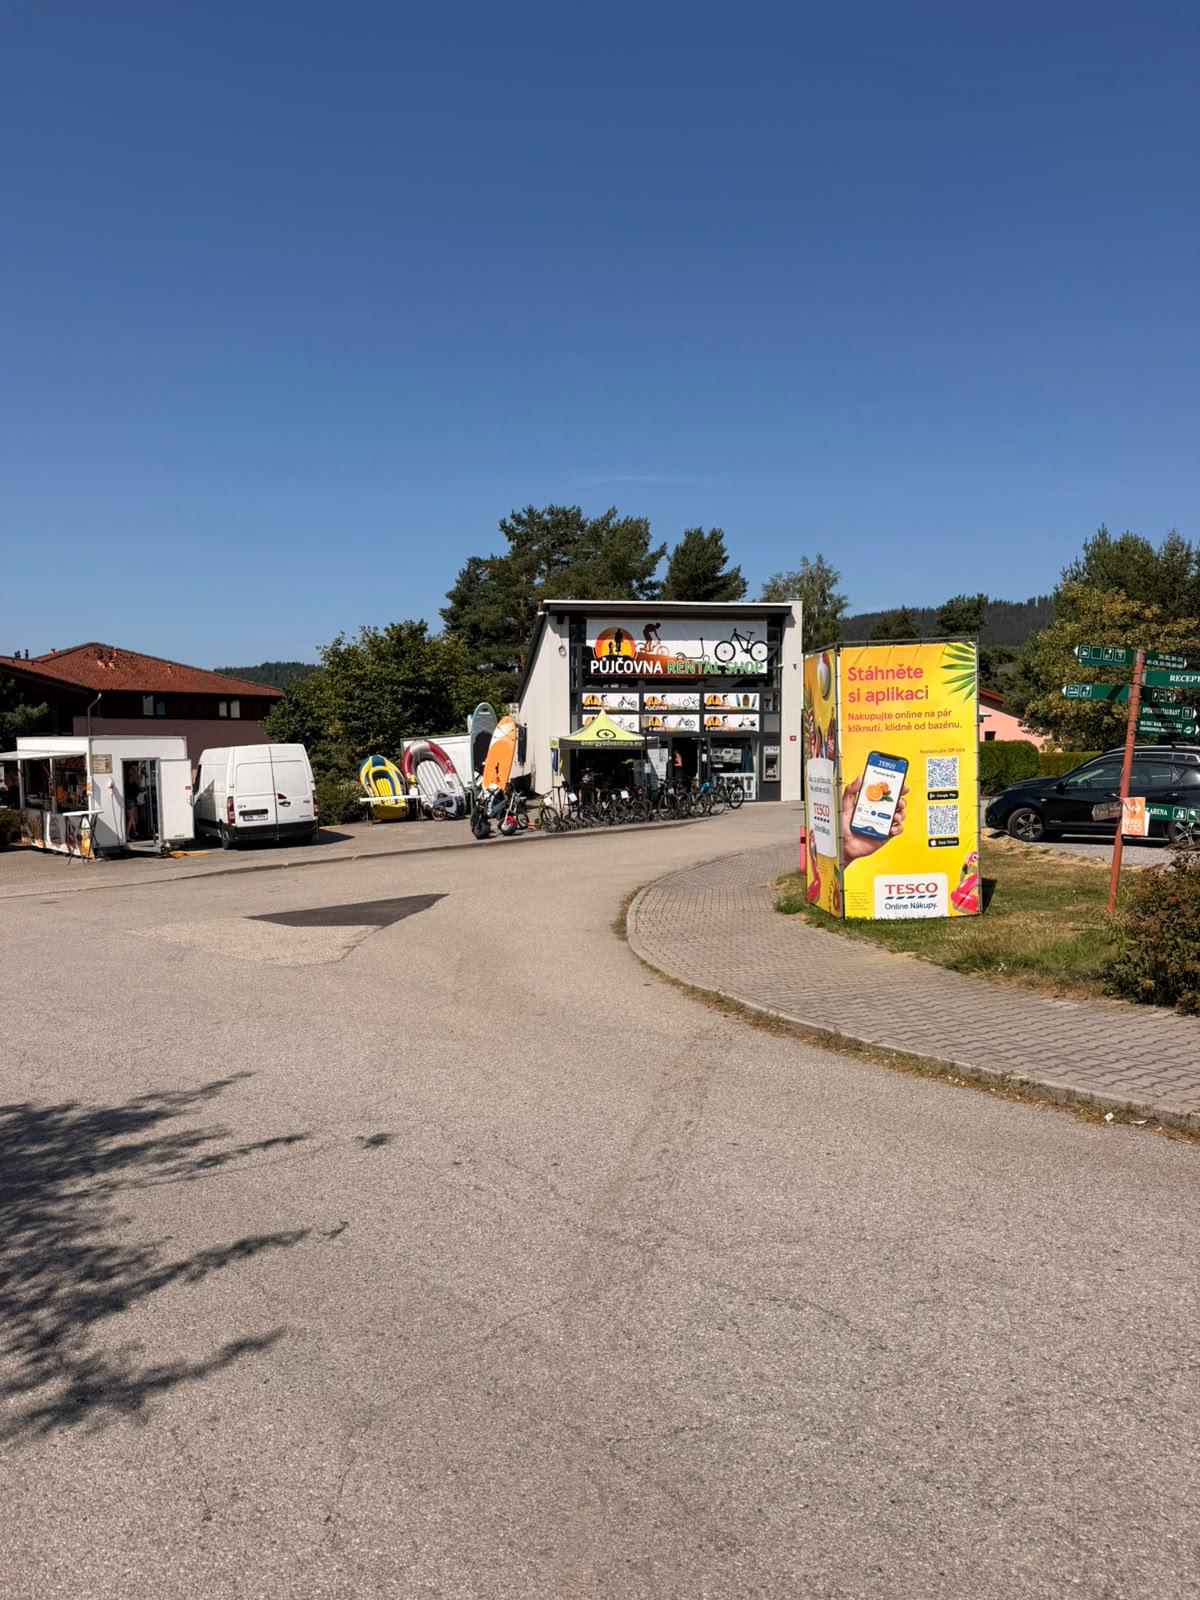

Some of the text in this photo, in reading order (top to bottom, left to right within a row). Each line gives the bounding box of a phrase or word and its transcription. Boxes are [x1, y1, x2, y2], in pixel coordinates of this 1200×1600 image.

[590, 656, 763, 675] PŮJČOVNA RENTAL SHOP
[847, 663, 924, 682] Stáhněte
[848, 685, 929, 705] si aplikaci
[848, 711, 893, 721] Nakupujte
[895, 710, 923, 719] online
[937, 709, 952, 719] pár
[847, 720, 963, 733] kliknutí, klidně od bazénu.
[1149, 807, 1168, 816] ARENA
[884, 882, 938, 895] TESCO
[884, 902, 909, 910] Online
